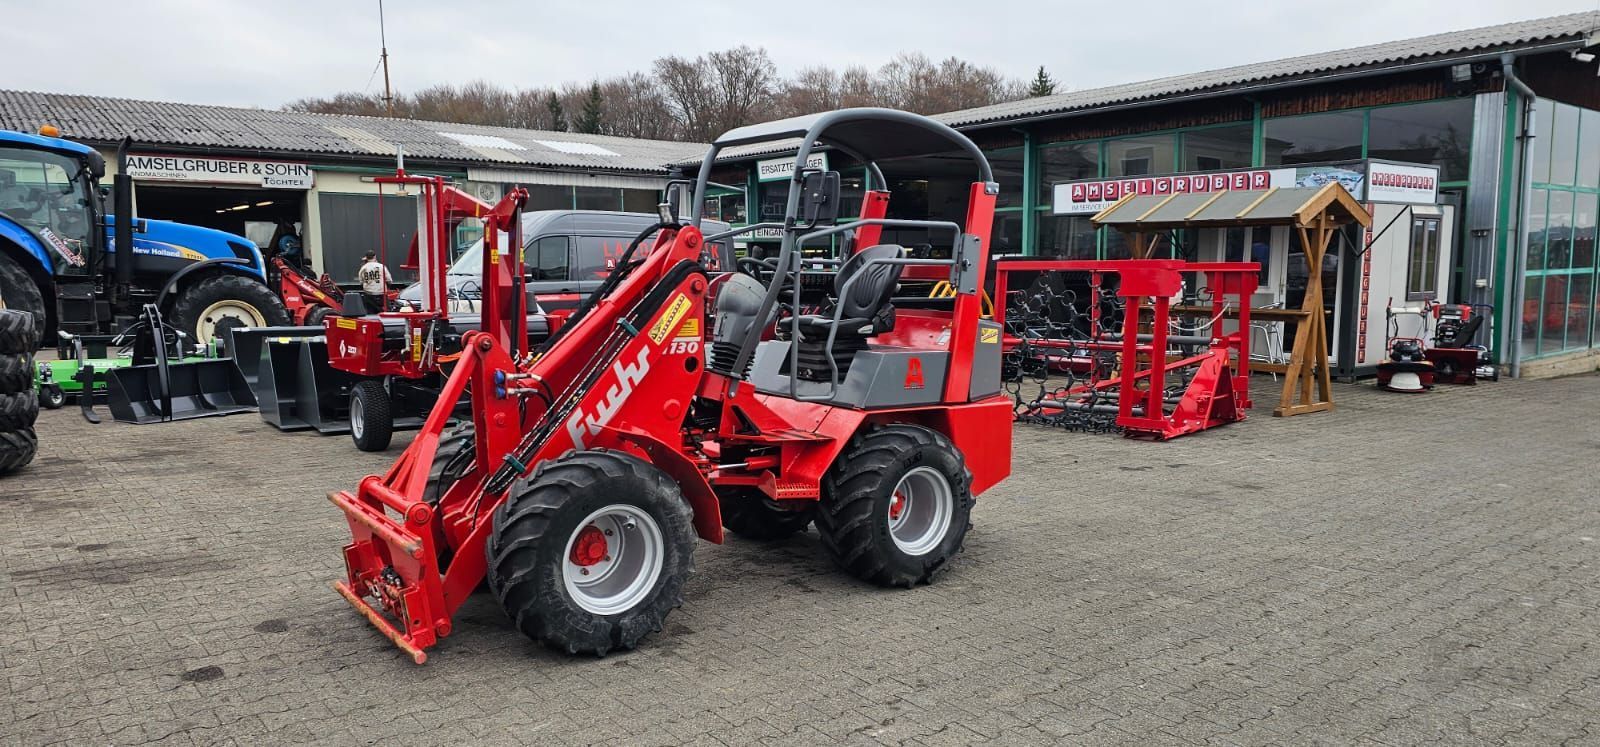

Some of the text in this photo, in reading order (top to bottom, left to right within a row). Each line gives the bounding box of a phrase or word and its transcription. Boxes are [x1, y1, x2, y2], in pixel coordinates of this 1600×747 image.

[126, 156, 309, 177] AMSELGRUBER & SOHN
[1073, 174, 1266, 197] AMSELGRUBER
[757, 228, 784, 237] EINGAN
[152, 247, 180, 257] Holland
[567, 344, 650, 450] Fuchs
